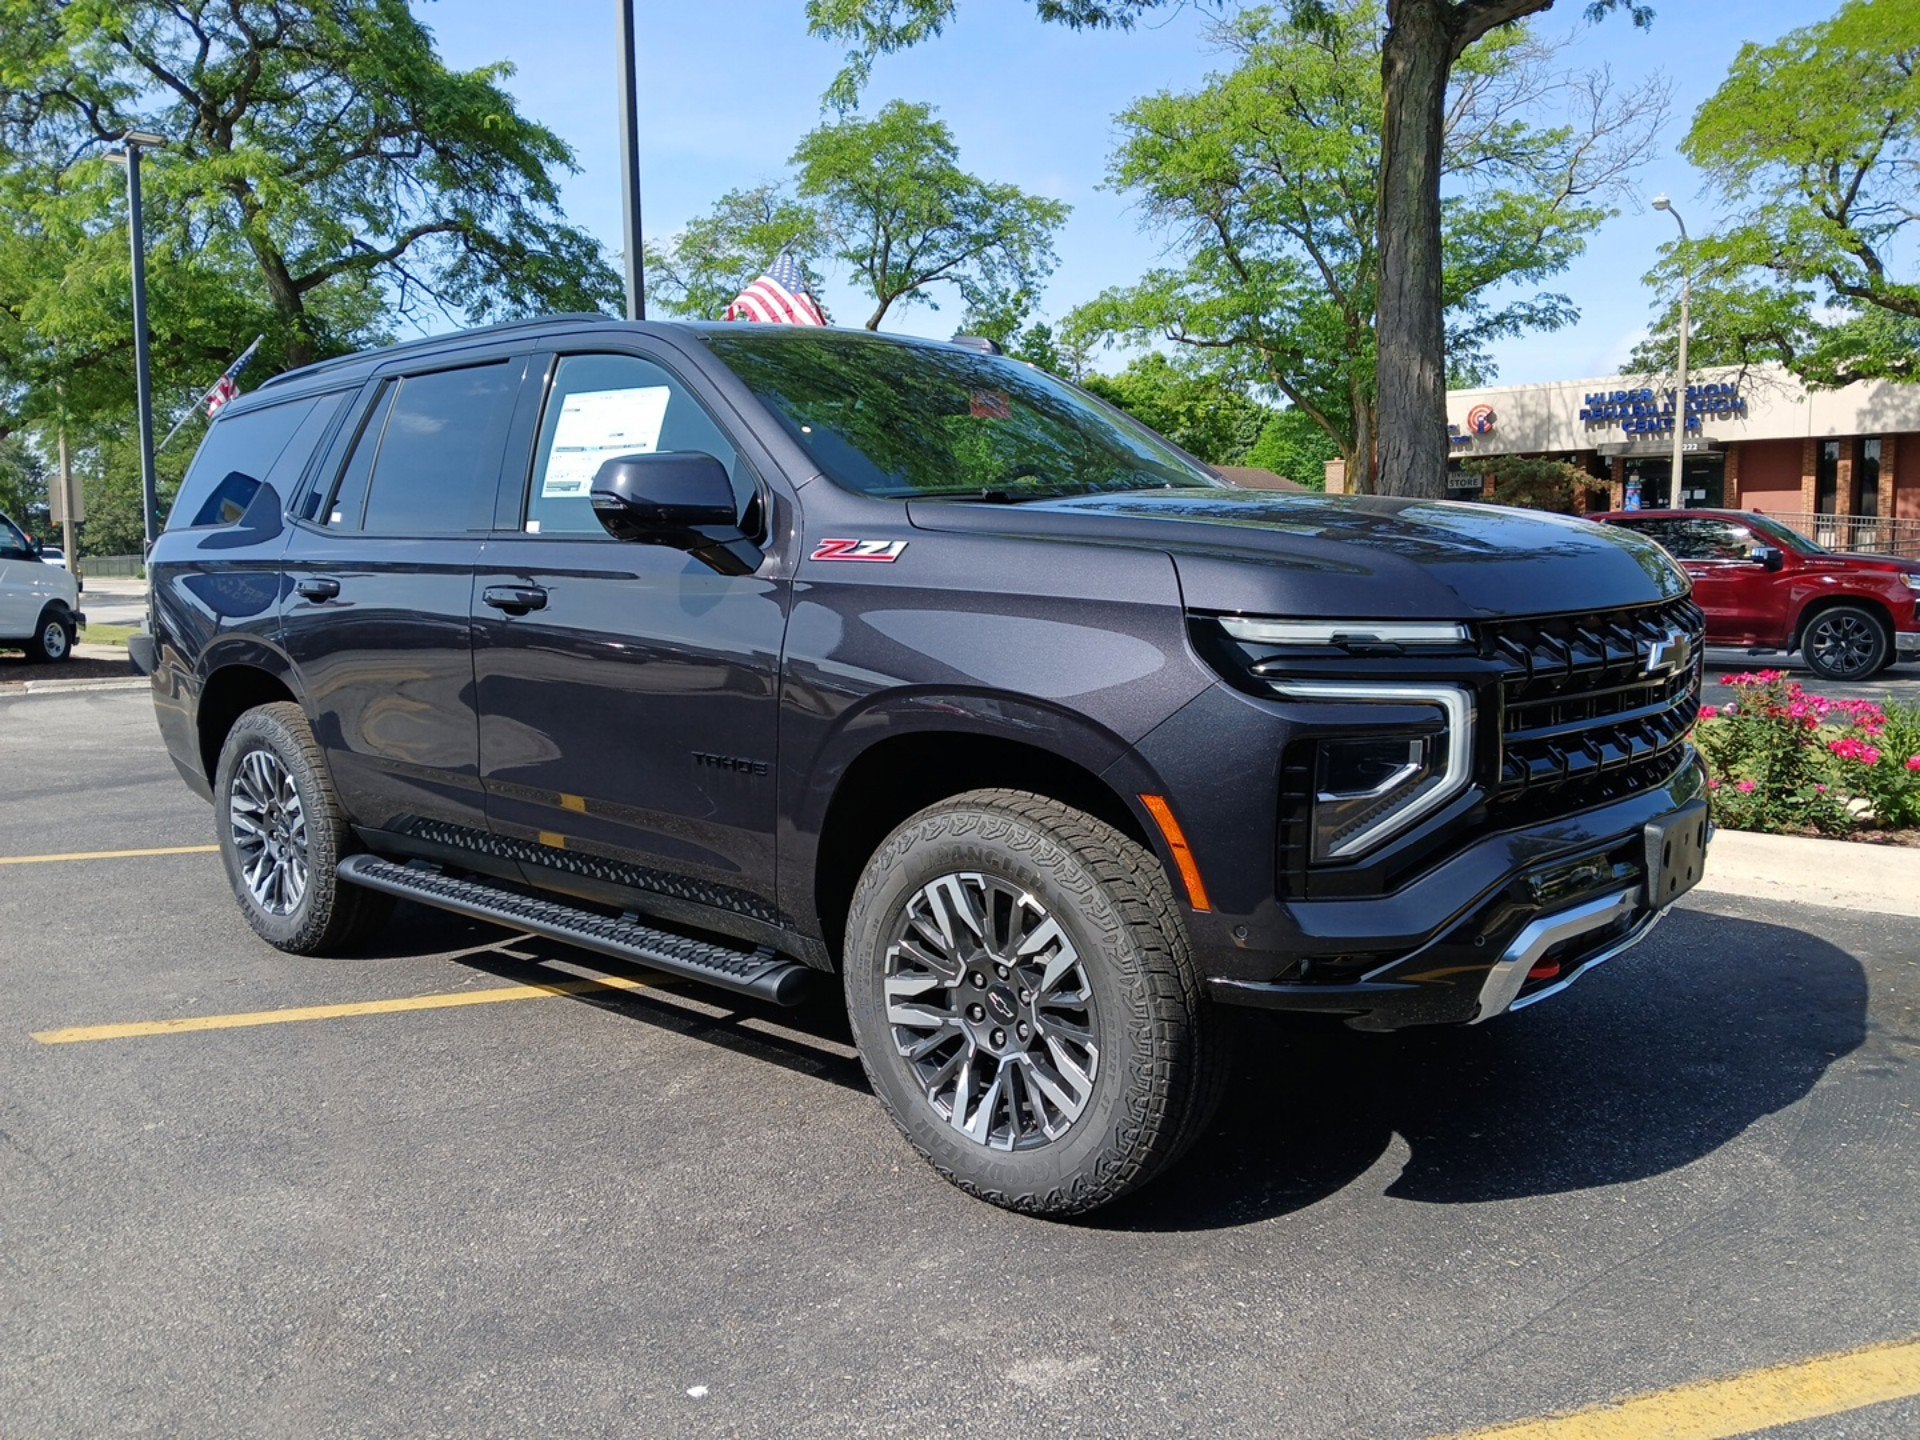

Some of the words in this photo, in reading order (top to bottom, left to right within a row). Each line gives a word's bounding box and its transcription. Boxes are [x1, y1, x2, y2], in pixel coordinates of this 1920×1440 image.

[1585, 388, 1654, 405] HUBER
[1664, 382, 1736, 401] VSION
[1579, 396, 1748, 421] REHABILIATION
[1622, 415, 1700, 433] CENTR
[1449, 479, 1478, 487] STORE
[809, 538, 909, 562] Z71
[691, 751, 768, 776] TAHOE
